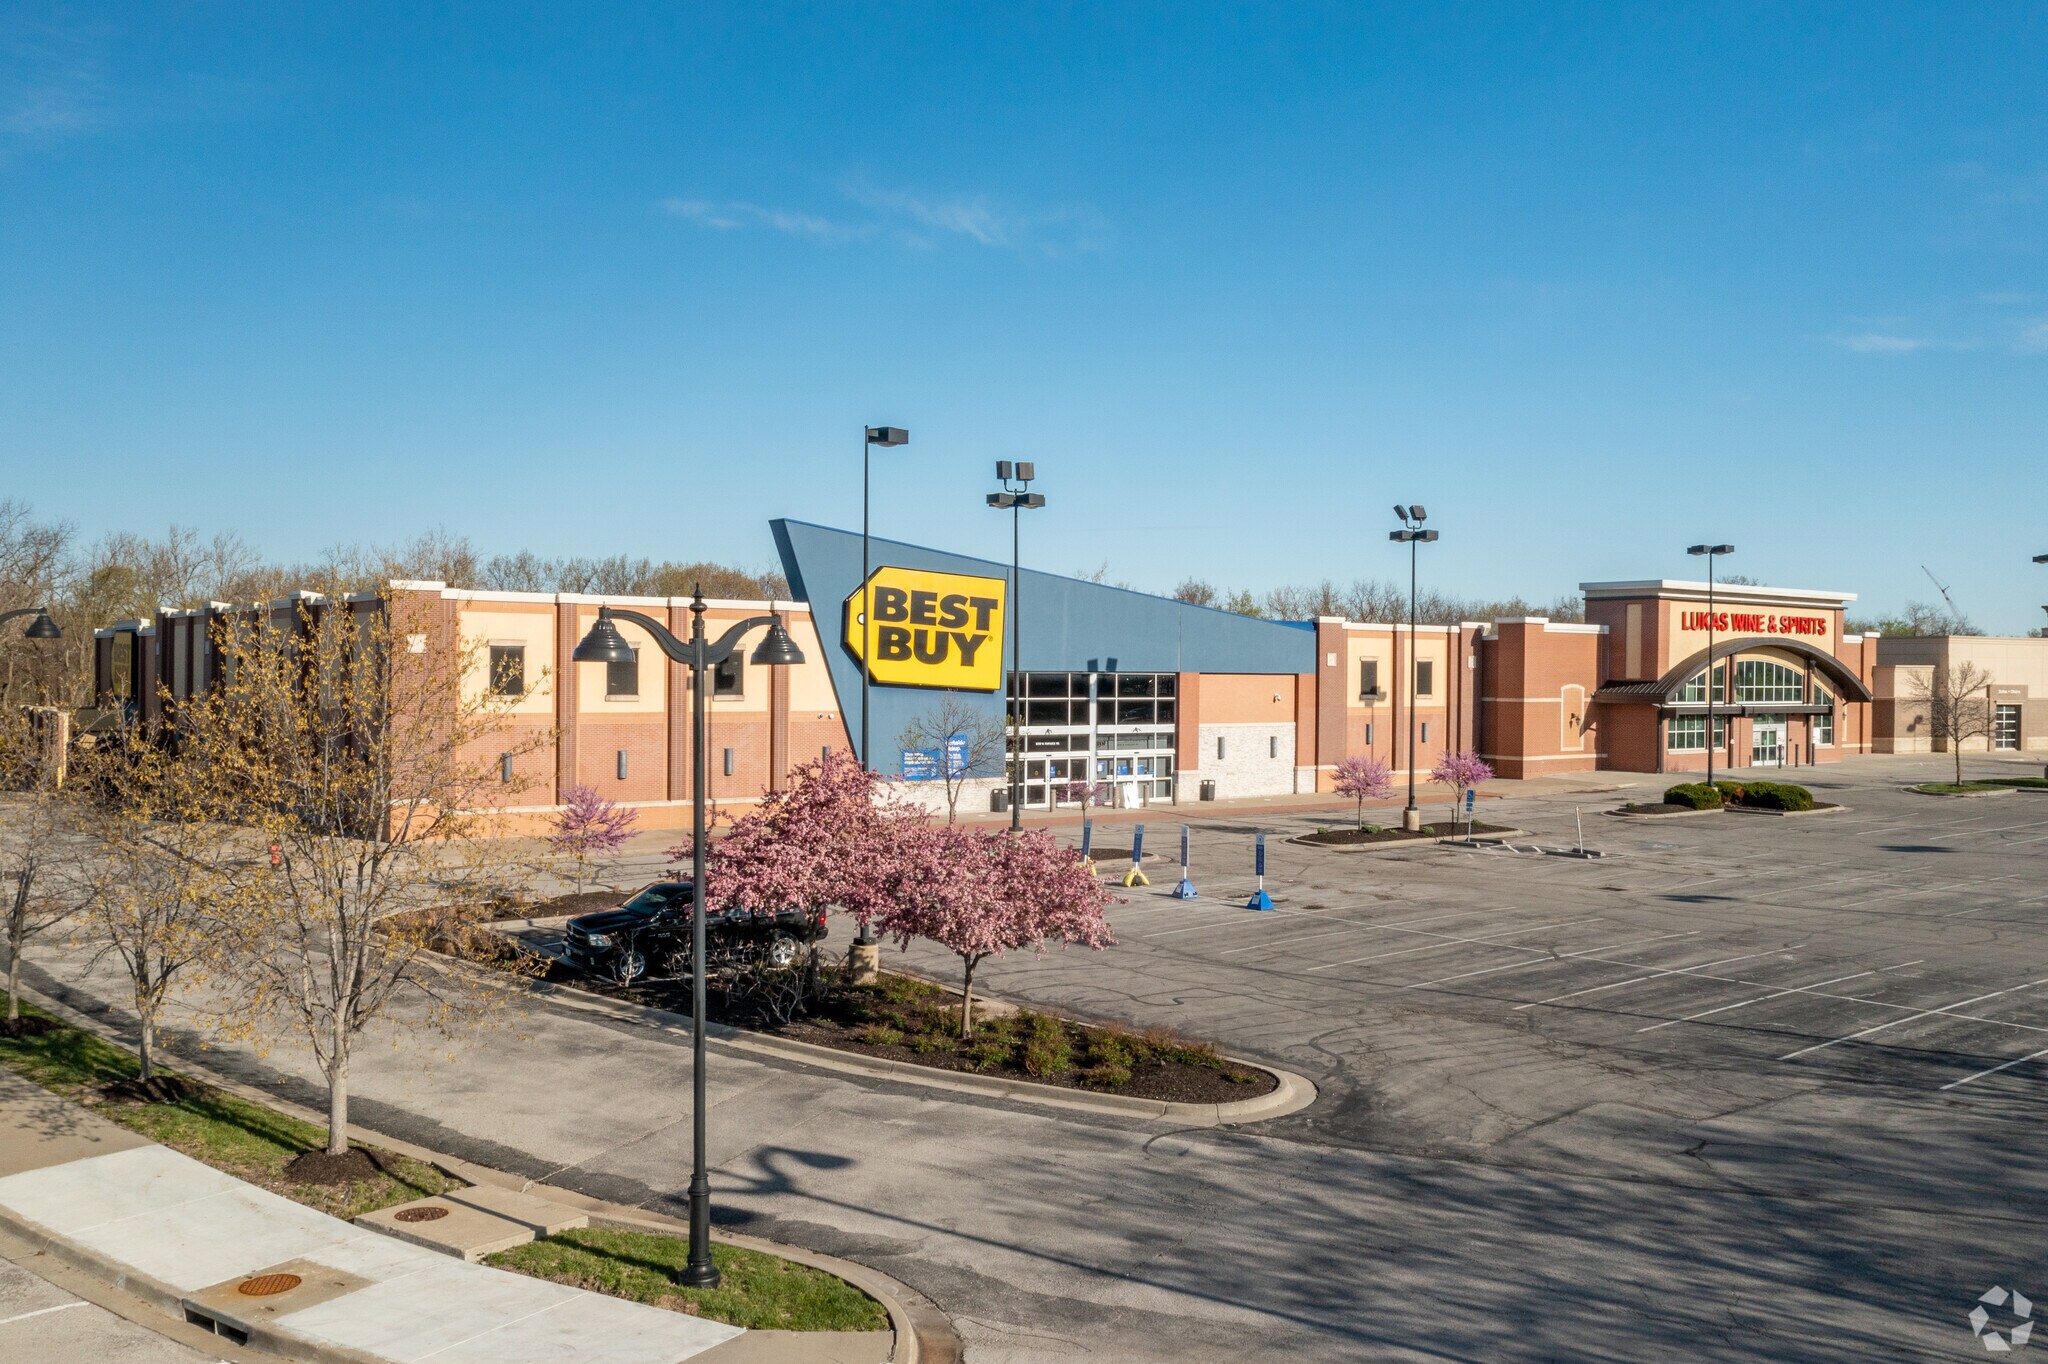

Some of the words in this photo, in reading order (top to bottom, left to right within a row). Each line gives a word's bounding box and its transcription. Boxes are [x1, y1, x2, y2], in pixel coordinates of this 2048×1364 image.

[873, 586, 999, 631] BEST
[1681, 611, 1729, 631] LUKAS
[1731, 613, 1765, 632] WINE
[1767, 615, 1777, 633] &
[1780, 615, 1827, 636] SPIRITS
[877, 625, 988, 667] BUY
